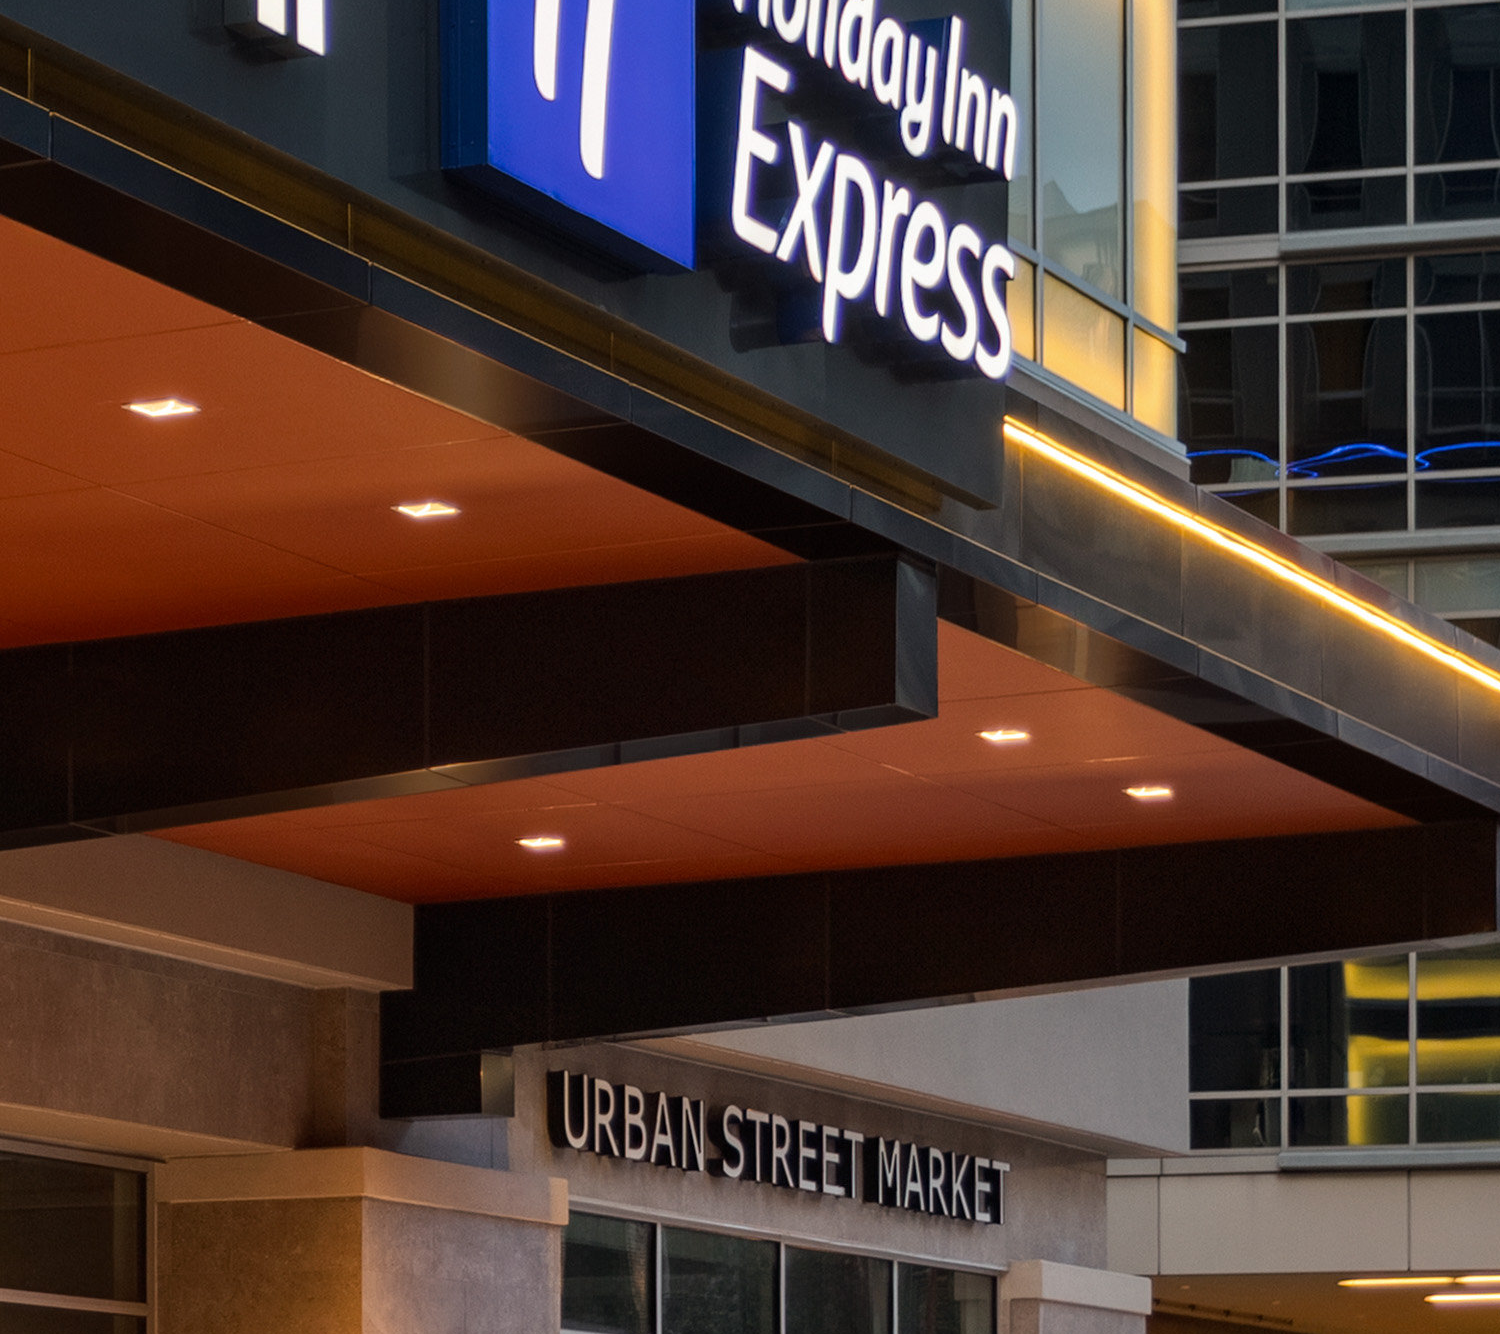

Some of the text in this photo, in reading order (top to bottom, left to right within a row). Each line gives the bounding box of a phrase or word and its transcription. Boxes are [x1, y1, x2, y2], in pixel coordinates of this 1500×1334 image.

[942, 15, 1019, 181] Inn
[731, 46, 1015, 379] Express
[563, 1070, 1011, 1225] URBAN STREET MARKET
